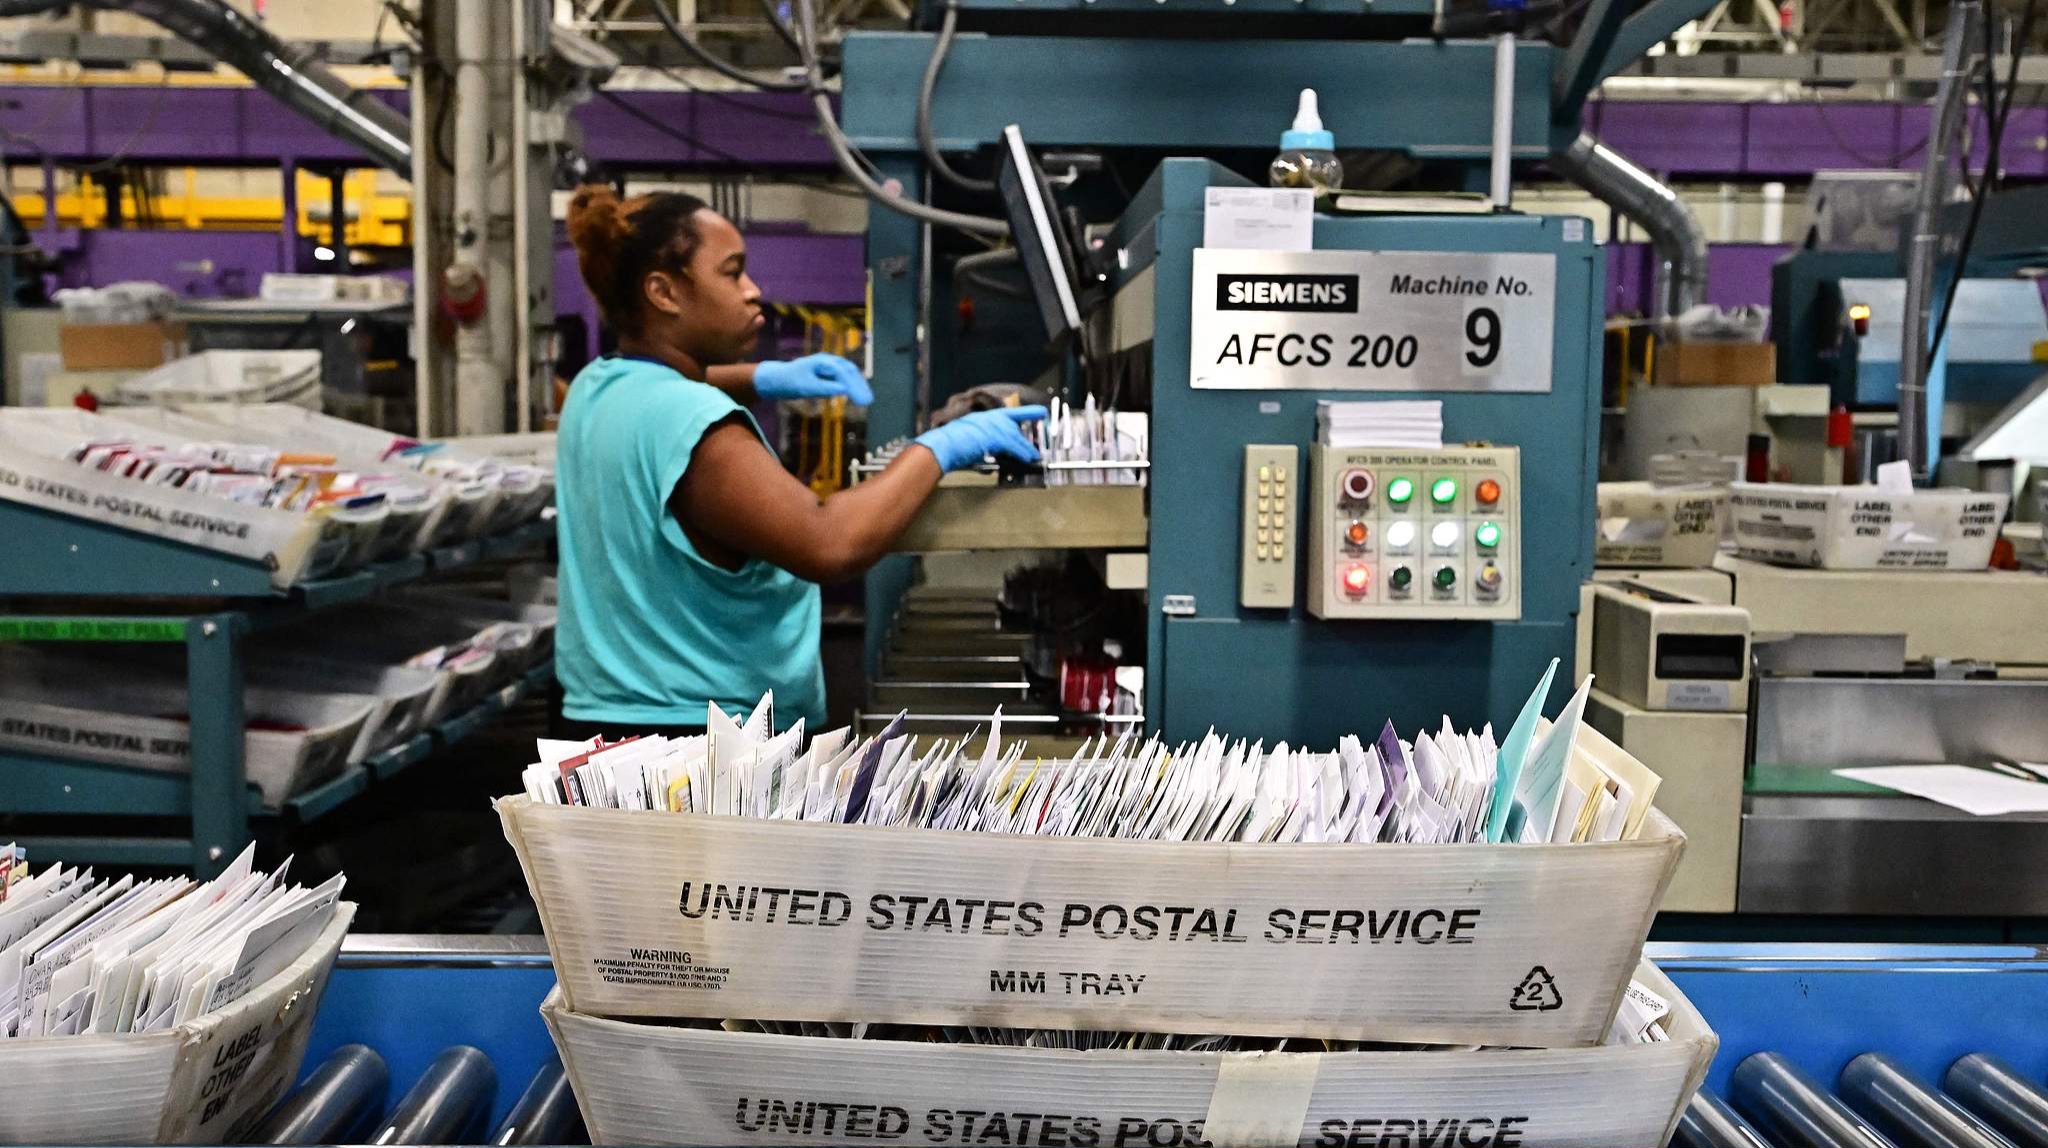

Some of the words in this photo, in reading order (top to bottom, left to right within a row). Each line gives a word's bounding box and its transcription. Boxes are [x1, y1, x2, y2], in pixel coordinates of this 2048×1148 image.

[1227, 281, 1347, 305] SIEMENS
[1390, 275, 1488, 296] Machine
[1496, 276, 1533, 296] No.
[1465, 308, 1501, 367] 9
[1216, 333, 1333, 367] AFCS
[1347, 335, 1418, 368] 200
[1431, 456, 1467, 466] CONTROL
[24, 475, 89, 505] STATES
[94, 496, 163, 523] POSTAL
[168, 509, 250, 539] SERVICE
[1855, 501, 1892, 512] LABEL
[1963, 502, 1995, 513] LABEL
[1851, 514, 1892, 524] OTHER
[1959, 515, 1995, 525] OTHER
[1856, 527, 1881, 537] END
[1962, 528, 1986, 538] END
[72, 728, 144, 753] POSTAL
[679, 881, 852, 927] UNITED
[866, 893, 1045, 937] STATES
[1058, 903, 1247, 942] POSTAL
[1264, 908, 1481, 945] SERVICE
[593, 958, 626, 967] MAXIMUM
[627, 961, 656, 969] PENALTY
[630, 948, 692, 963] WARNING
[603, 976, 624, 984] YEARS
[608, 968, 633, 976] POSTAL
[633, 970, 669, 978] PROPERTY
[990, 969, 1046, 994] MM
[1058, 972, 1146, 996] TRAY
[1526, 982, 1543, 1001] 2
[213, 1023, 263, 1069] LABEL
[201, 1051, 256, 1099] OTHER
[736, 1097, 910, 1139] UNITED
[923, 1108, 1101, 1147] STATES
[1315, 1115, 1529, 1147] SERVICE
